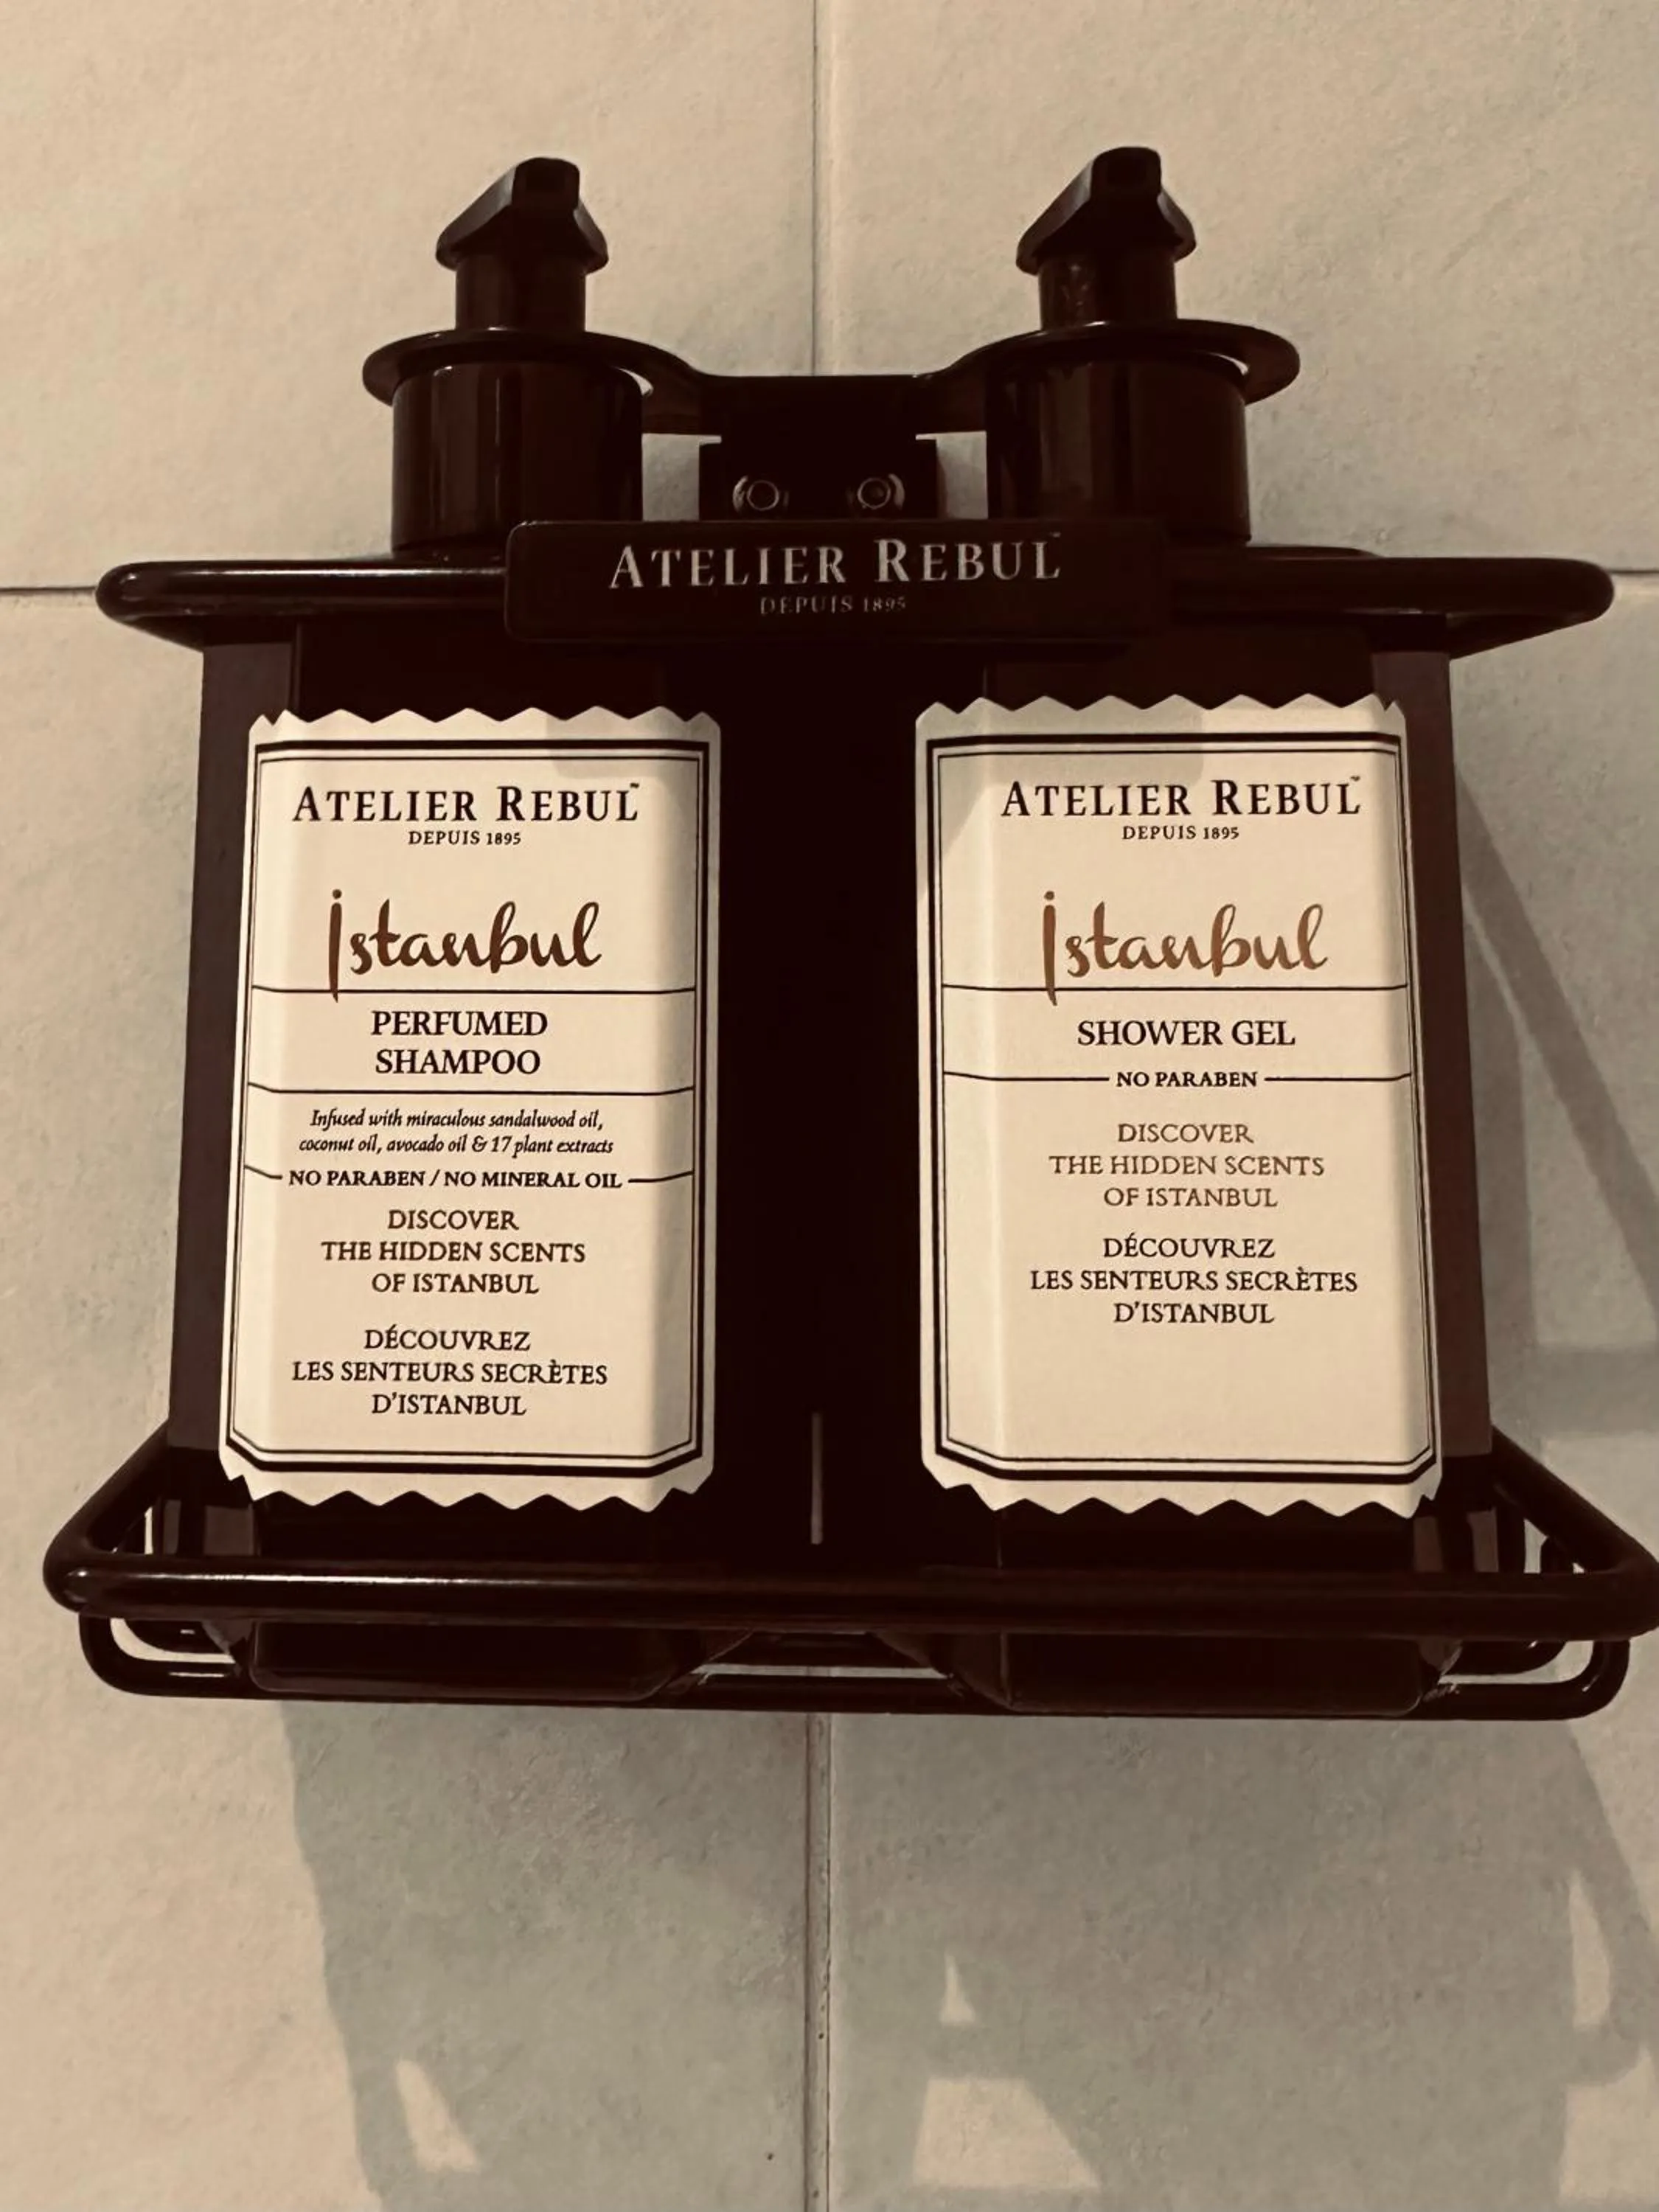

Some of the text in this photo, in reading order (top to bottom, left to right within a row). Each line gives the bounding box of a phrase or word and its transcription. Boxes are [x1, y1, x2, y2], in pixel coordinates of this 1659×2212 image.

[609, 545, 846, 588] ATELIER
[759, 596, 907, 615] DEPUIS 1895
[292, 785, 478, 822] ATELIER
[1001, 781, 1192, 816] ATELIER
[408, 830, 521, 846] DEPUIS 1895
[1121, 826, 1239, 840] DEPUIS 1895
[371, 1011, 548, 1037] PERFUMED
[1077, 1020, 1296, 1046] SHOWER GEL
[375, 1049, 541, 1074] SHAMPOO
[1116, 1072, 1257, 1087] NO PARABEN
[310, 1109, 604, 1132] Infused with miraculous sandalwood oil,
[1117, 1124, 1254, 1143] DISCOVER
[299, 1135, 613, 1158] coconut oil, avocado oil & 17 plant extracts
[1049, 1155, 1325, 1176] THE HIDDEN SCENTS
[288, 1170, 622, 1189] NO PARABEN / NO MINERAL OIL
[1104, 1188, 1278, 1208] OF ISTANBUL
[387, 1210, 520, 1231] DISCOVER
[321, 1241, 585, 1262] THE HIDDEN SCENTS
[1103, 1233, 1276, 1259] DÉCOUVREZ
[372, 1274, 539, 1294] OF ISTANBUL
[1031, 1267, 1357, 1293] LES SENTEURS SECRÈTES
[364, 1324, 531, 1352] DÉCOUVREZ
[292, 1359, 608, 1385] LES SENTEURS SECRÈTES
